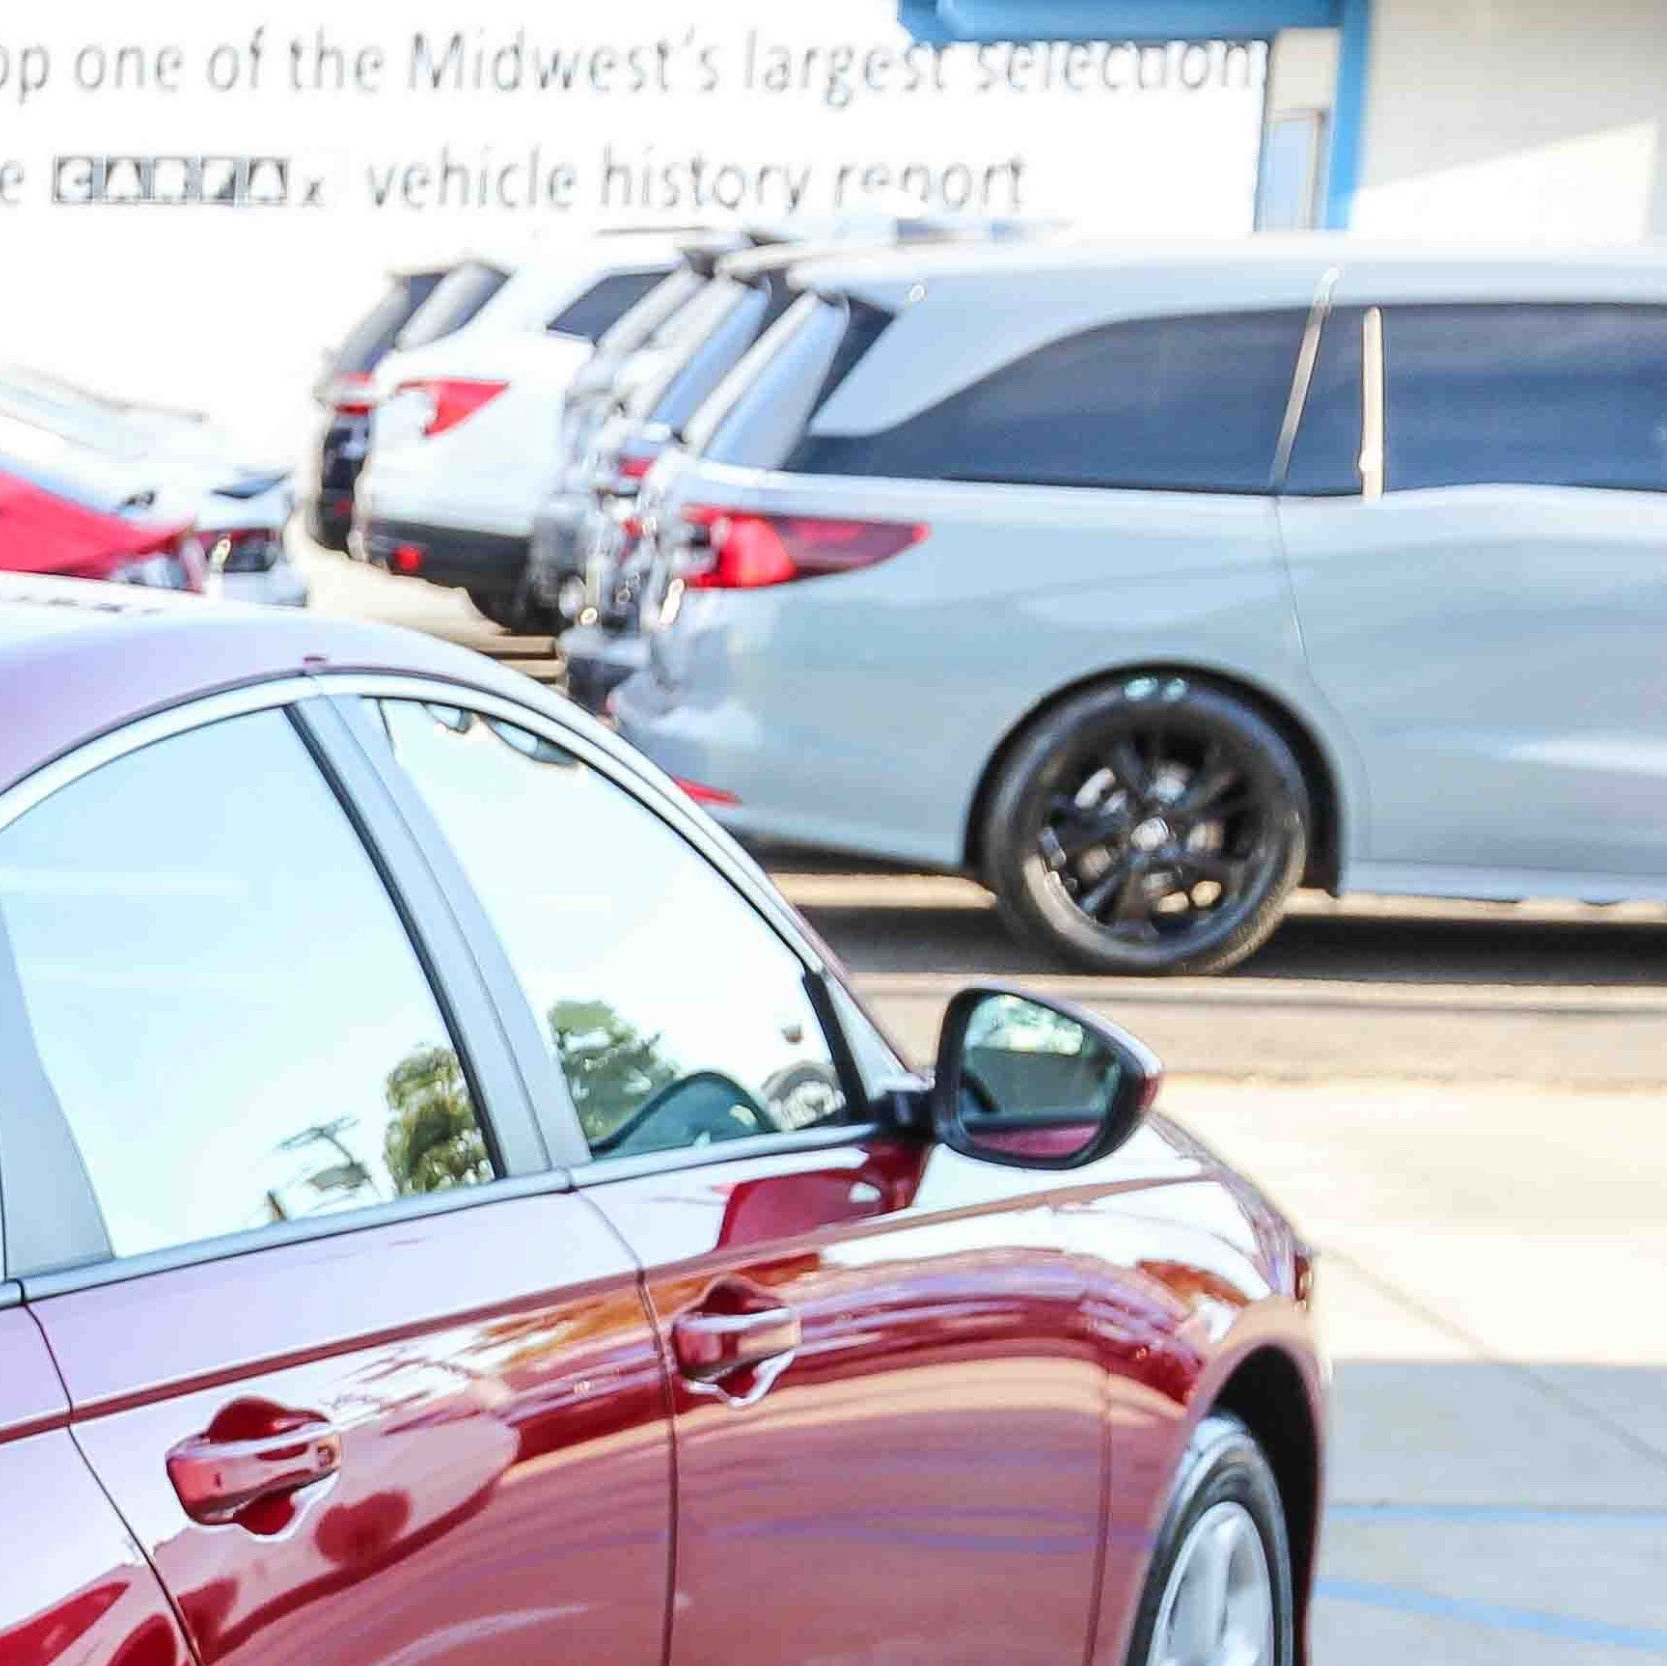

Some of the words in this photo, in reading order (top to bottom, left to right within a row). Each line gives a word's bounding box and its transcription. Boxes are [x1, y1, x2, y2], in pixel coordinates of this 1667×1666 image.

[74, 43, 183, 92] one
[206, 25, 265, 92] of
[287, 28, 384, 93] the
[407, 26, 720, 93] Midwest's
[744, 31, 948, 108] largest
[366, 145, 578, 209] vehicle
[598, 142, 812, 213] history
